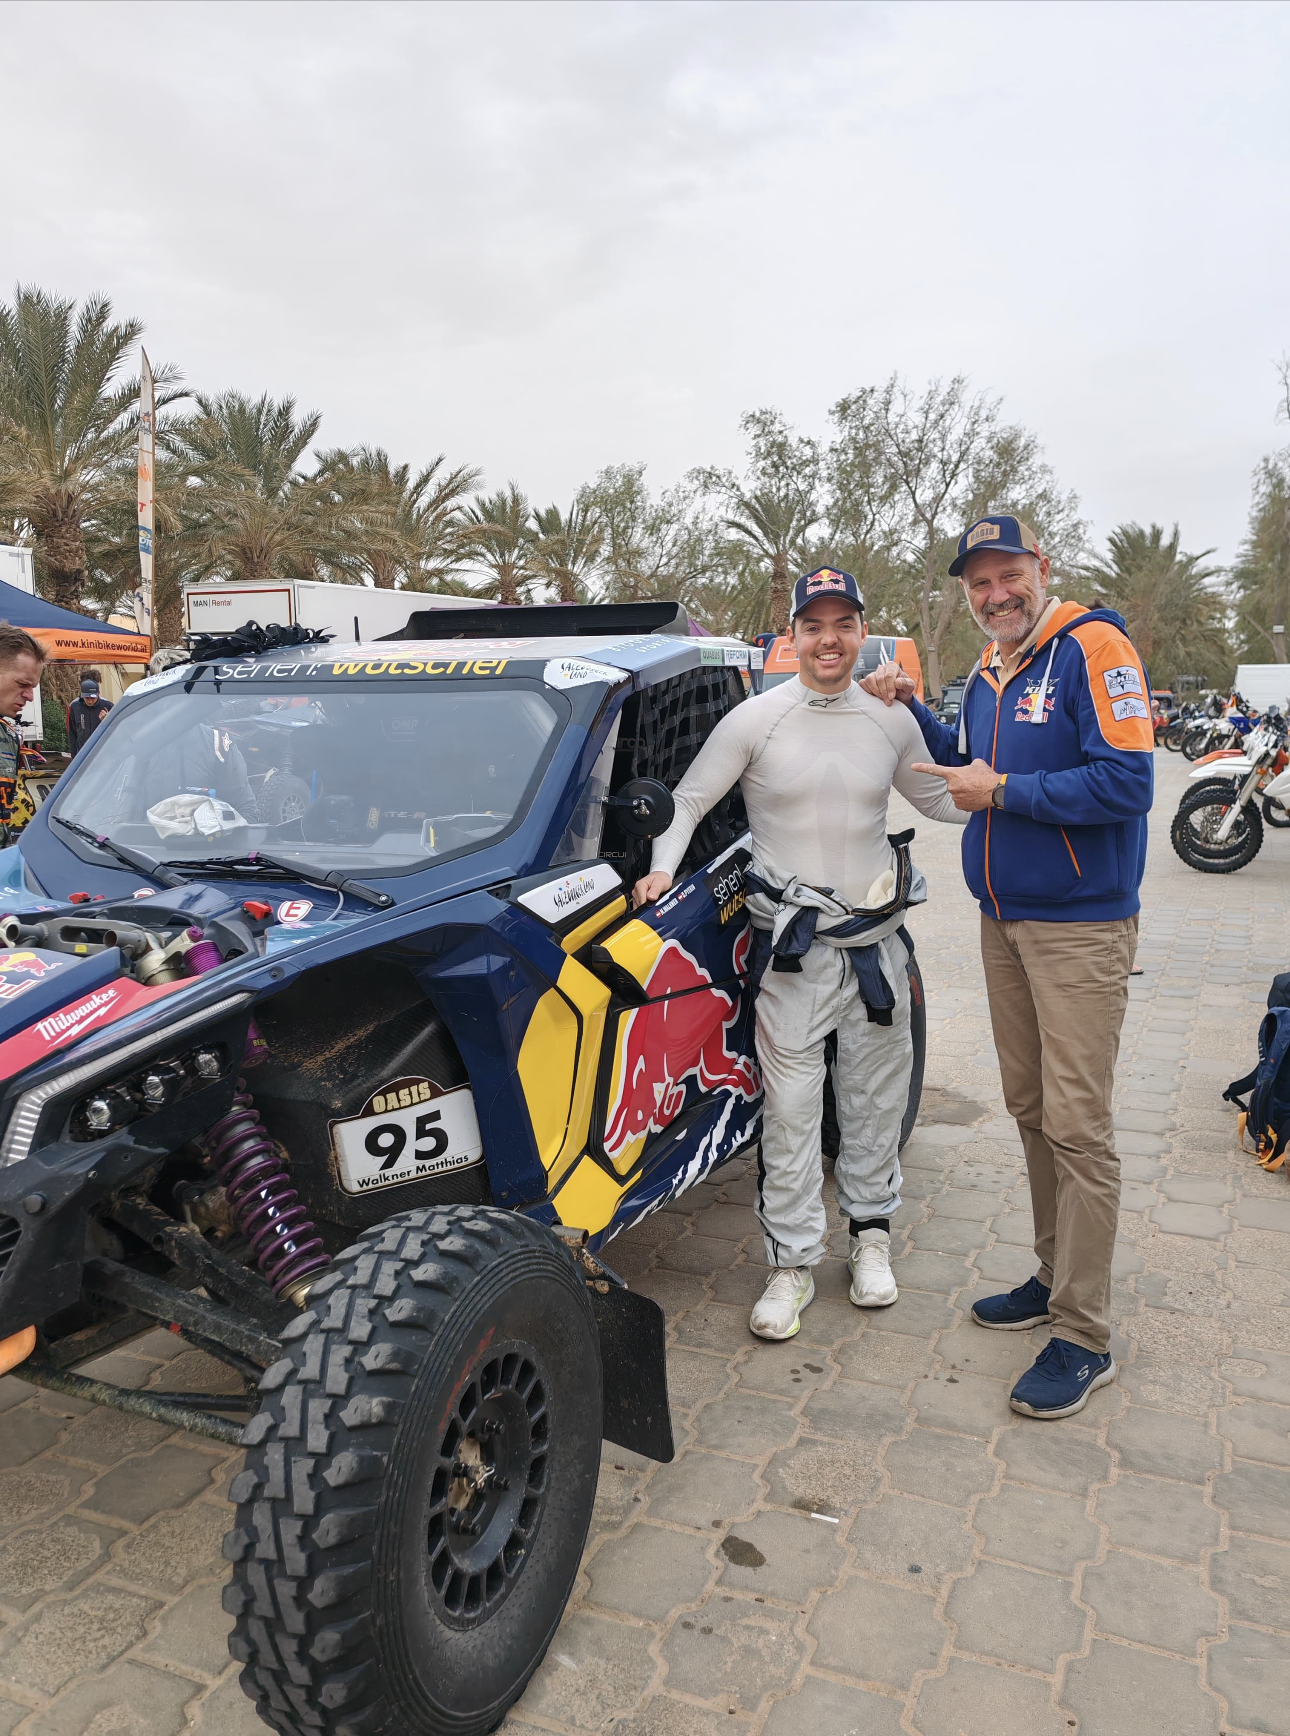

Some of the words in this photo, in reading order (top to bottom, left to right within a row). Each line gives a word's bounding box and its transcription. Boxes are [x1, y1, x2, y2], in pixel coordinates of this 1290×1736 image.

[807, 581, 827, 595] Red
[827, 581, 847, 592] Bull
[192, 599, 208, 607] MAN
[54, 638, 148, 654] www.kinibikeworld.at
[726, 649, 747, 663] REFORM
[284, 901, 303, 918] E
[32, 987, 119, 1042] Milwaukee
[372, 1081, 432, 1113] OASIS
[364, 1109, 449, 1172] 95
[357, 1169, 413, 1189] Walkner
[415, 1154, 470, 1176] Matthias
